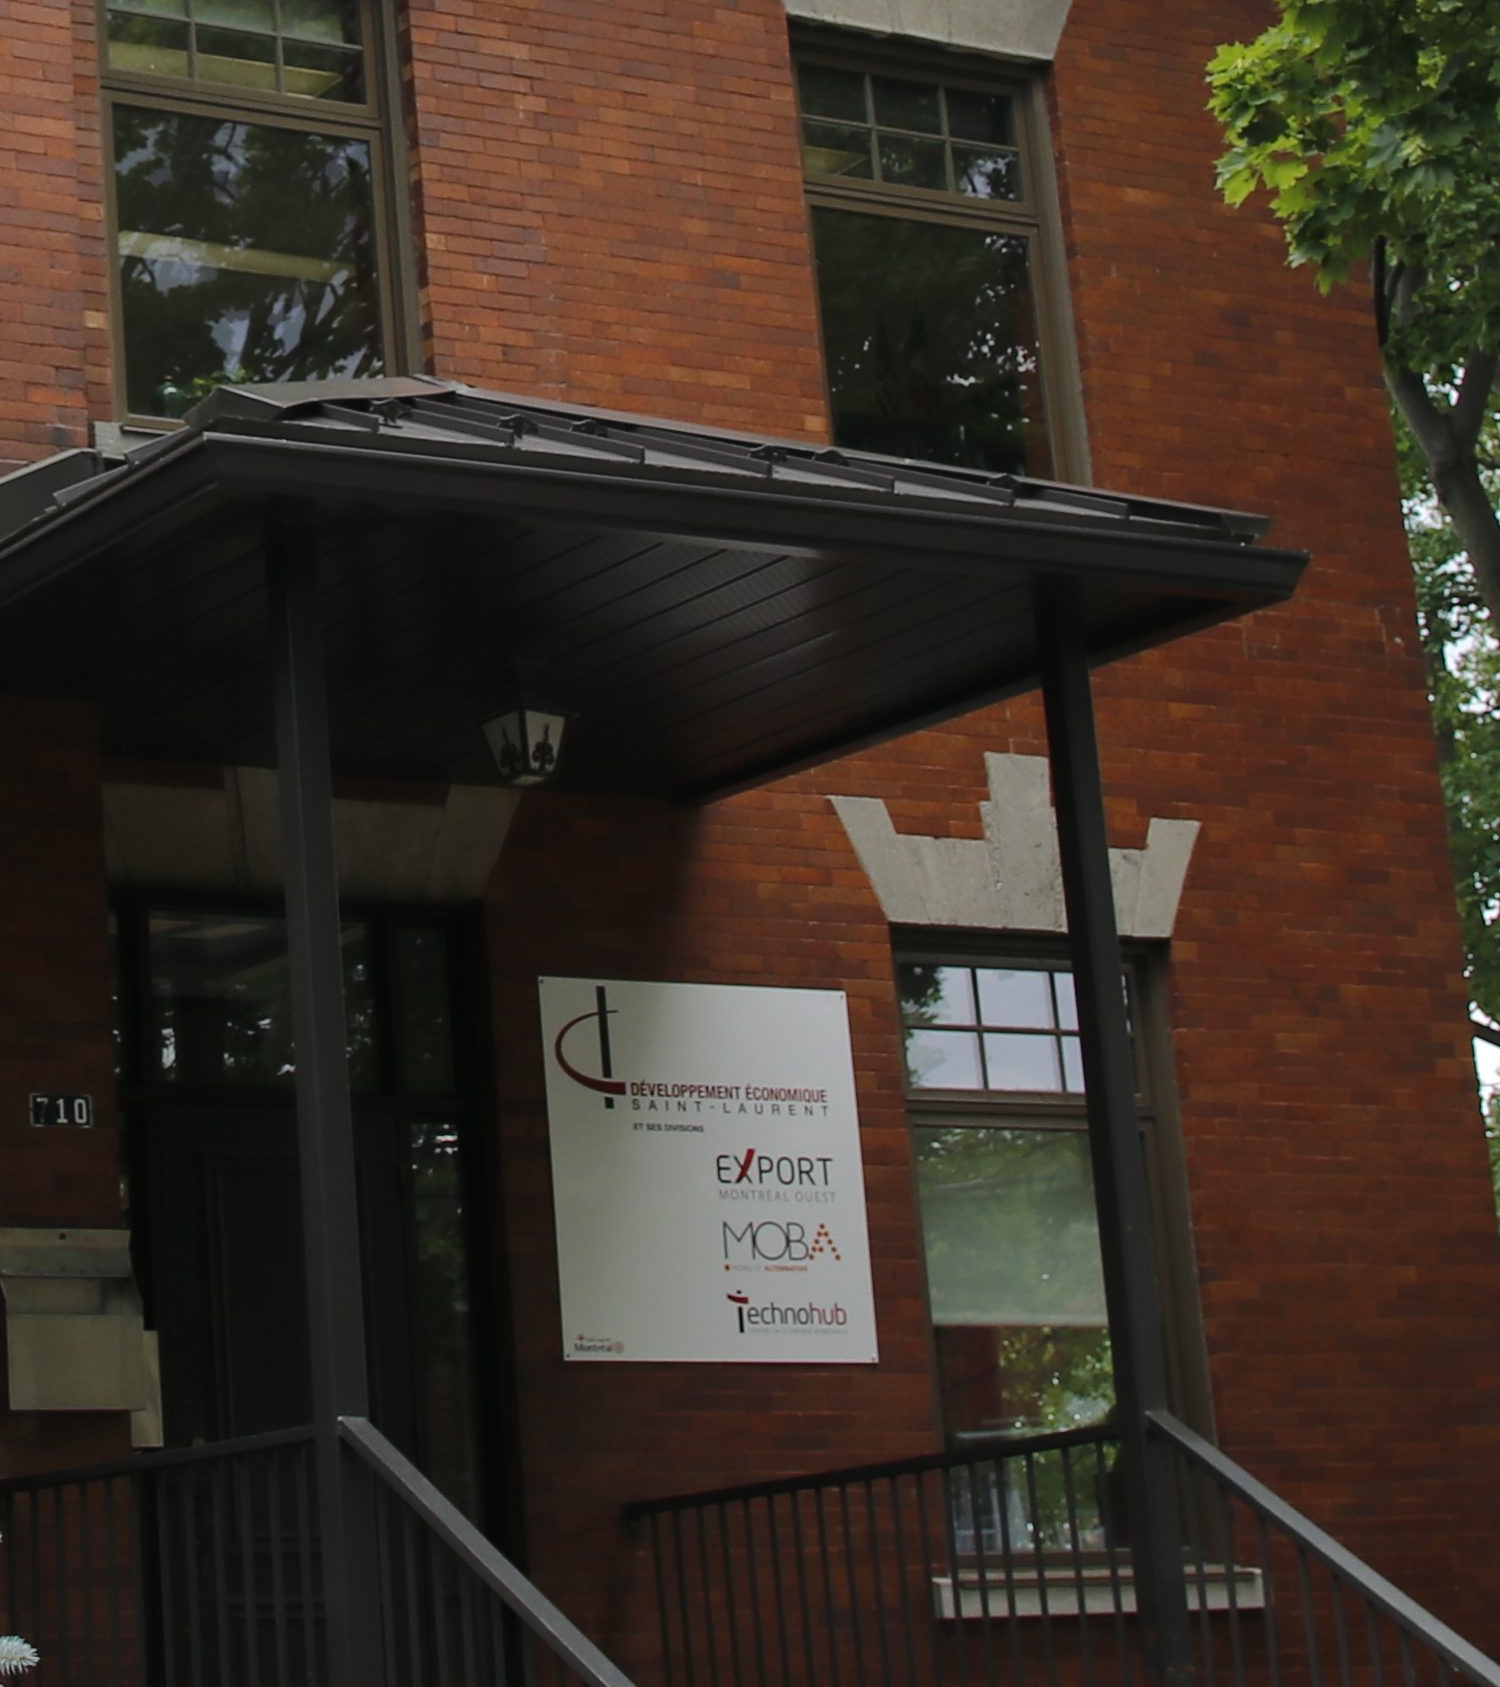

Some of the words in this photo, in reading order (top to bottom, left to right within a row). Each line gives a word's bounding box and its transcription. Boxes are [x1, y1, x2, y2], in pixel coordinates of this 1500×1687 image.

[630, 1079, 741, 1100] DÉVELOPPEMENT
[745, 1083, 828, 1103] ÉCONOMIQUE
[36, 1097, 88, 1124] 710
[631, 1098, 829, 1117] SAINT-LAURENT
[633, 1122, 644, 1132] ET
[646, 1122, 663, 1132] SES
[664, 1122, 705, 1134] DIVISIONS
[716, 1148, 833, 1186] EXPORT
[719, 1188, 790, 1203] MONTRÉAL
[794, 1190, 837, 1203] OUEST
[722, 1220, 841, 1262] MOBA
[726, 1289, 848, 1333] Technohub
